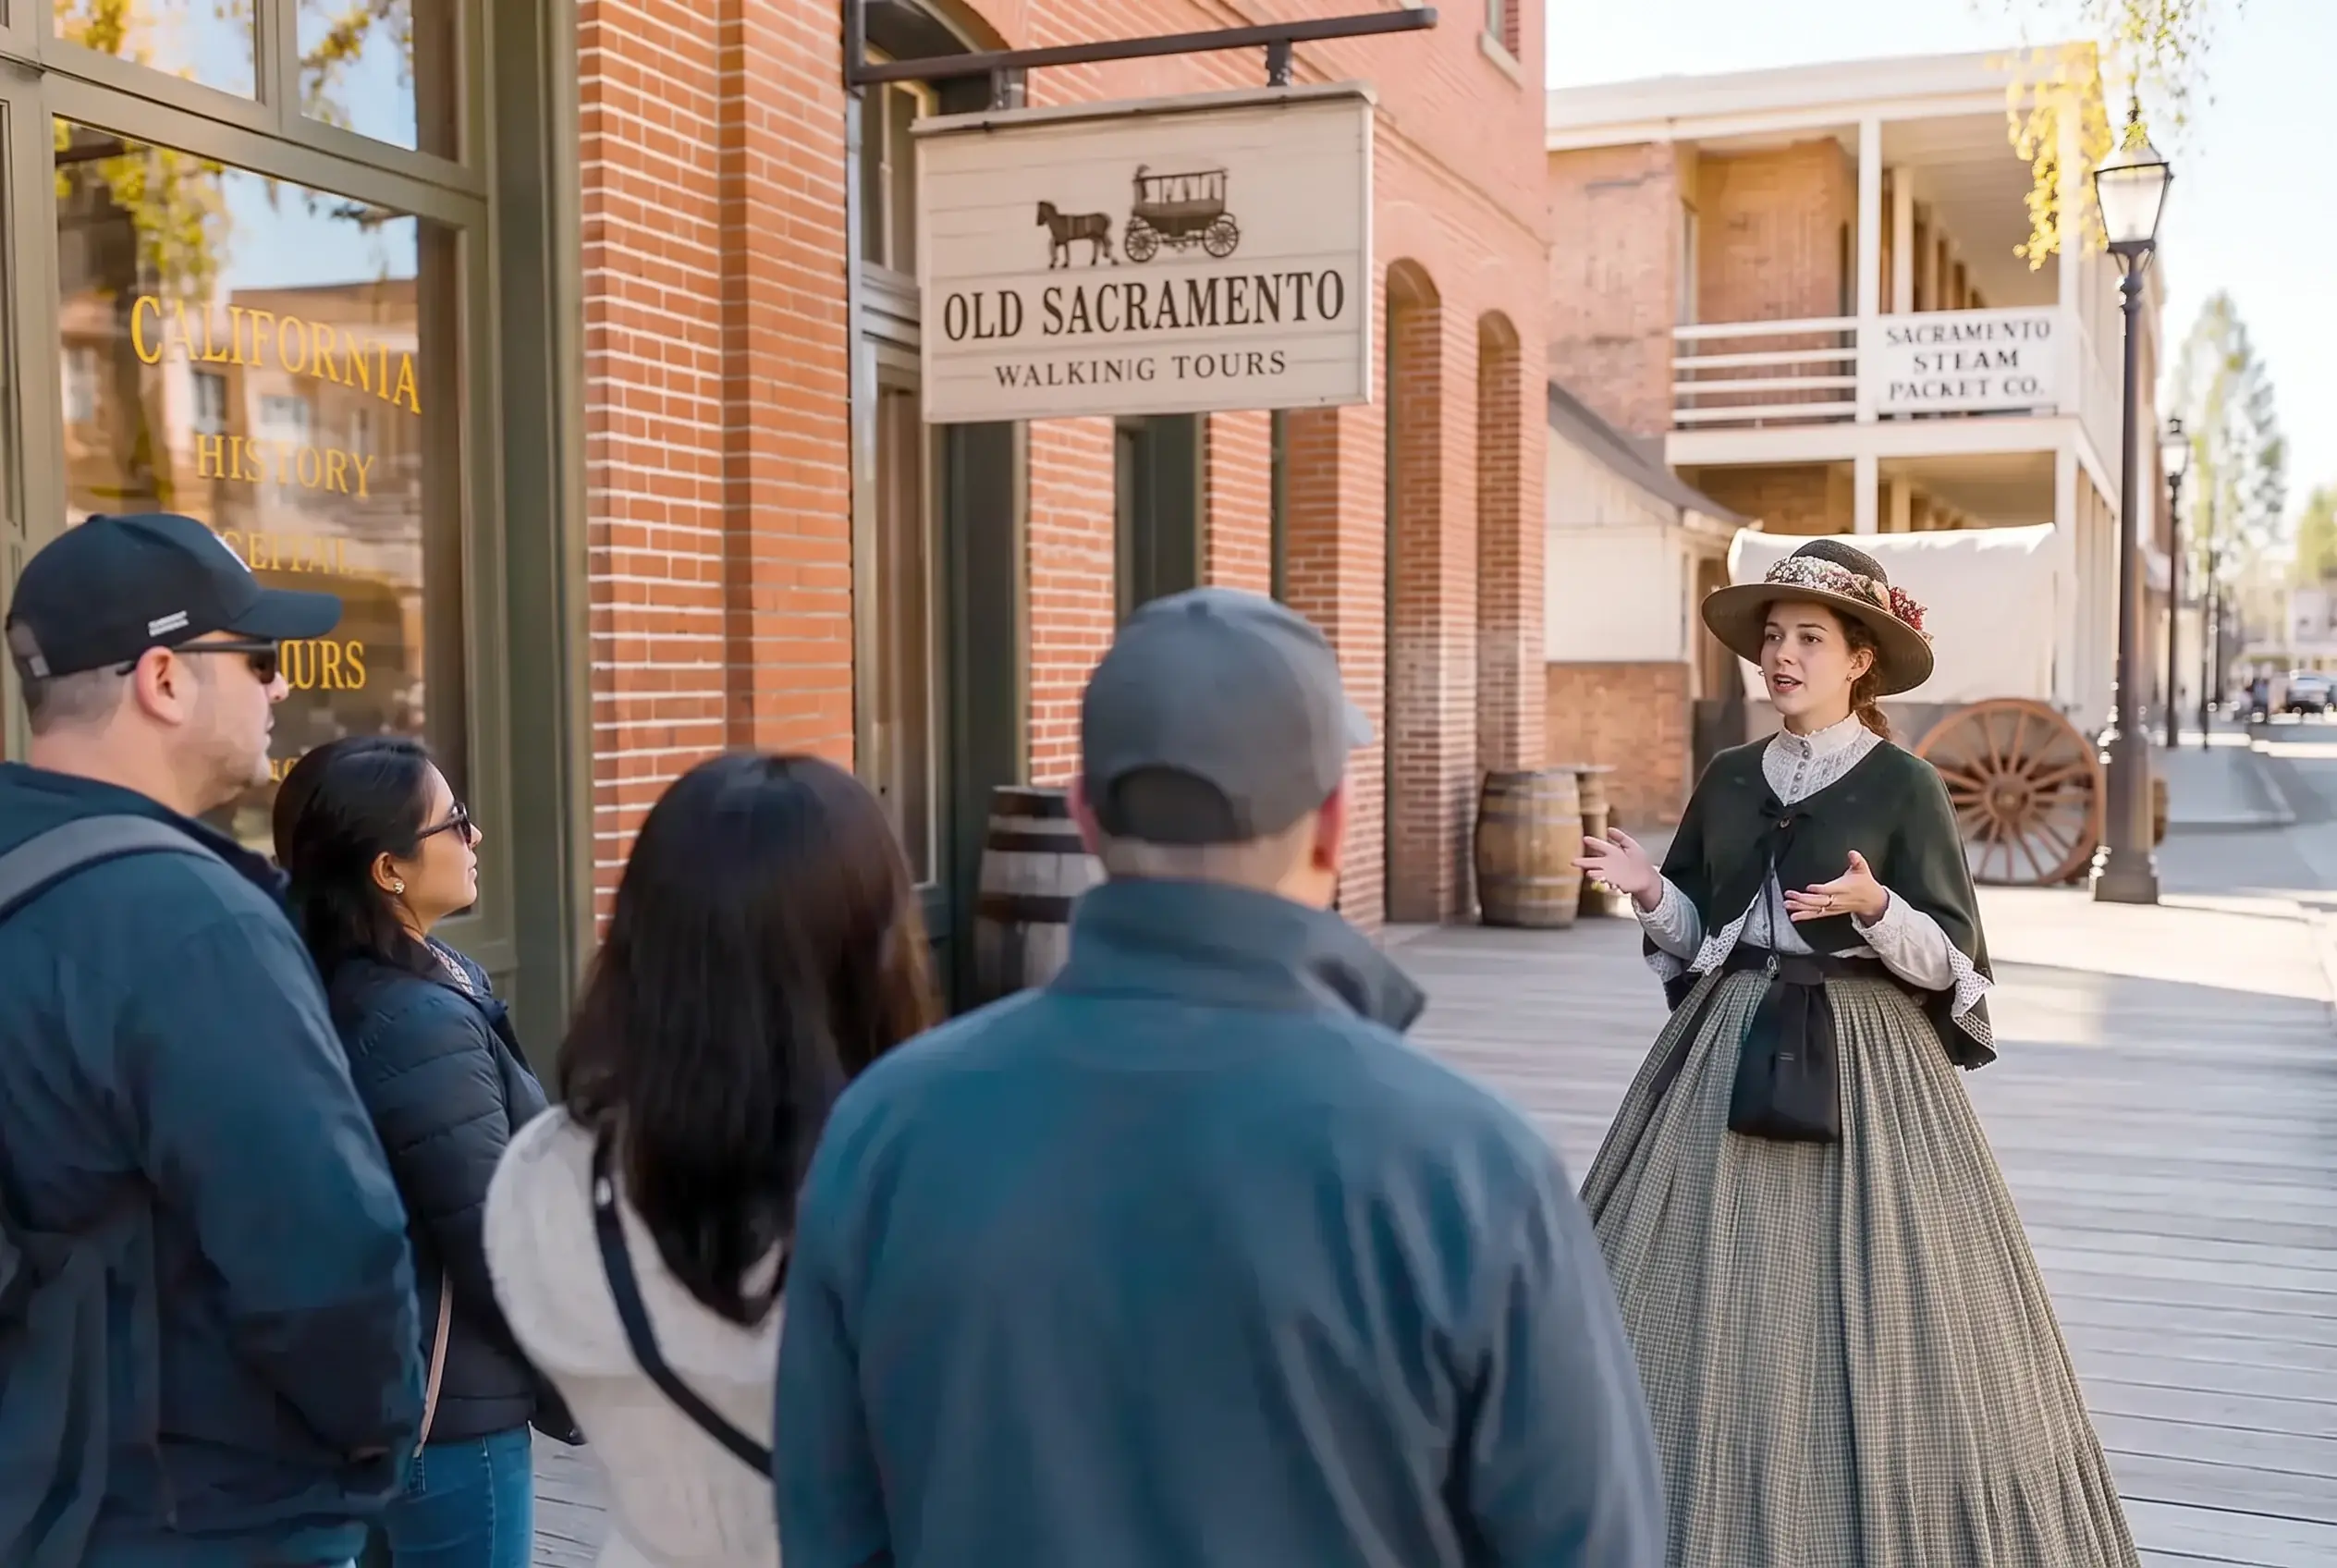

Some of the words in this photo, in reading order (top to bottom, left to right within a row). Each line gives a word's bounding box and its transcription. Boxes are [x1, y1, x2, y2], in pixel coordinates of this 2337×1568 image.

[944, 289, 1023, 341] OLD
[1042, 269, 1345, 336] SACRAMENTO
[1887, 320, 2051, 347] SACRAMENTO
[130, 295, 422, 415] CALIFORNIA
[1171, 350, 1287, 379] TOURS
[1914, 349, 2020, 374] STEAM
[1890, 378, 1989, 401] PACKET
[2003, 376, 2046, 397] CO.
[196, 434, 374, 497] HISTORY
